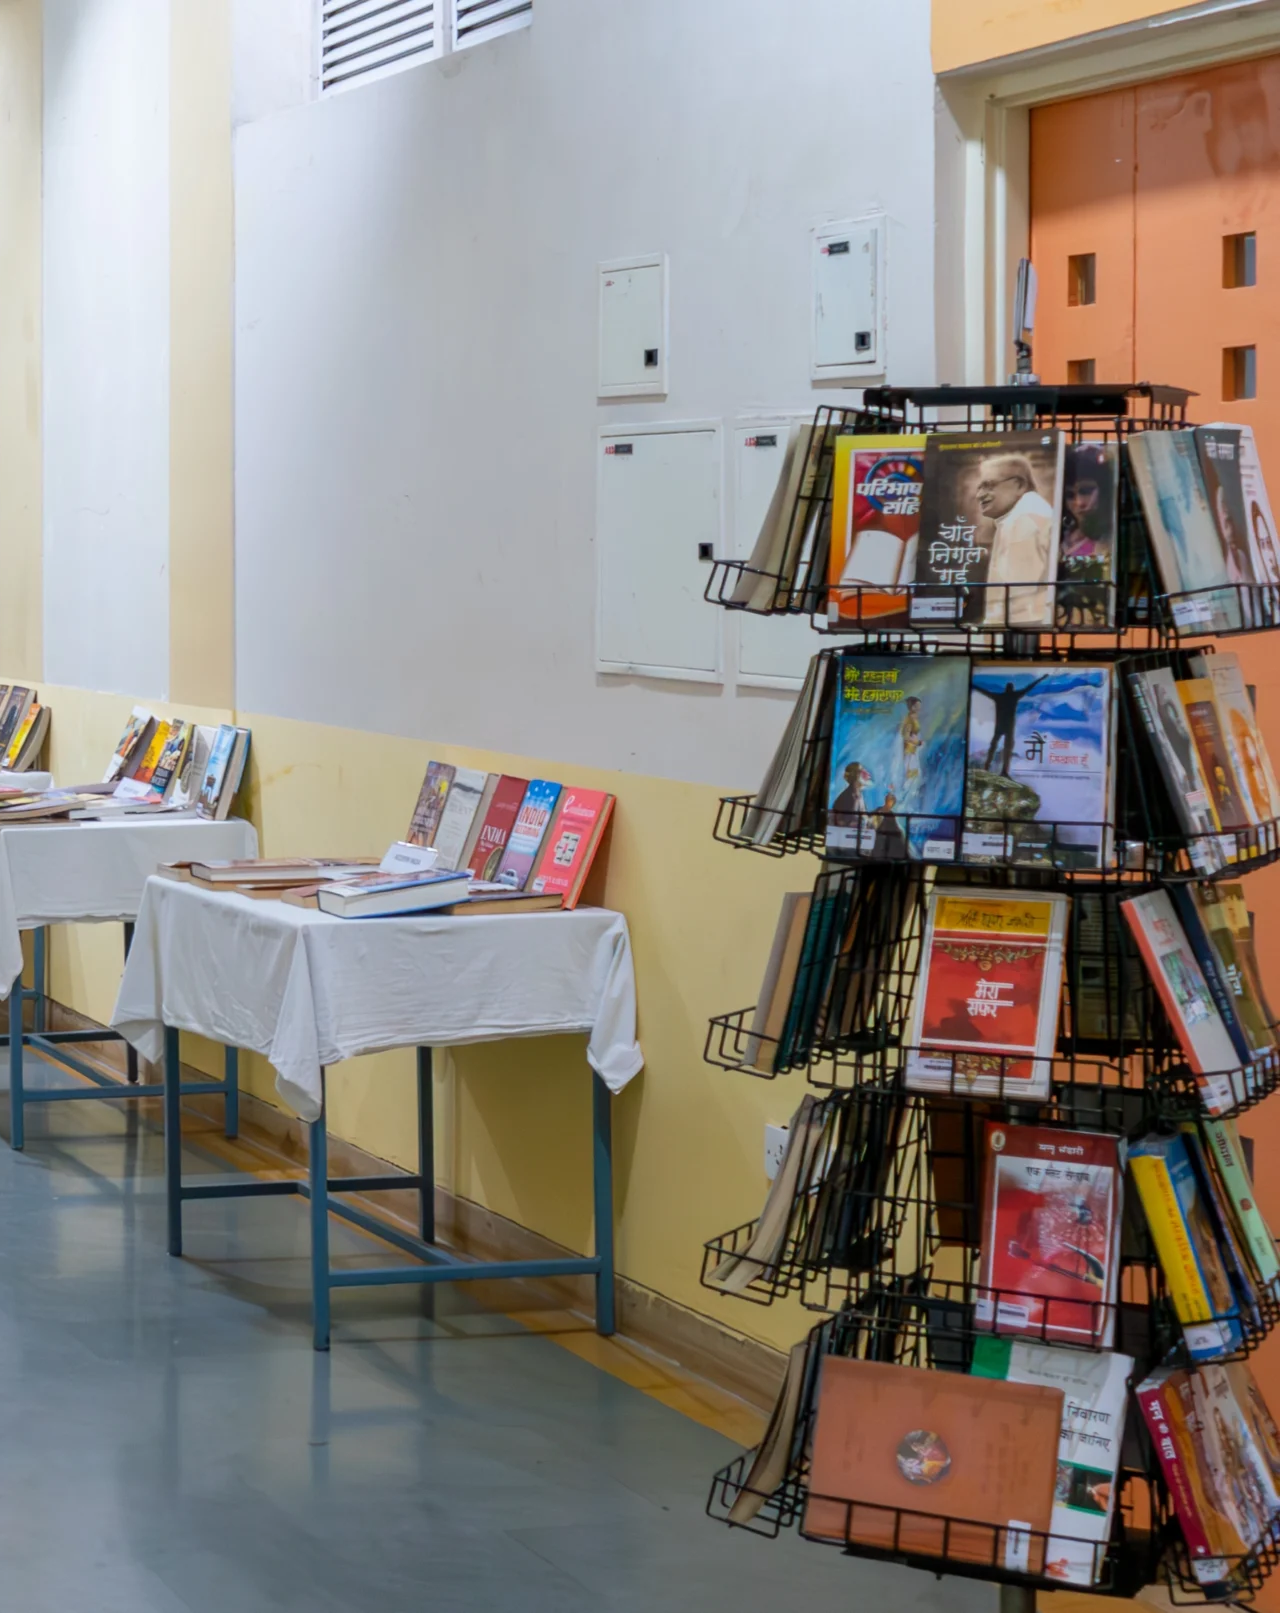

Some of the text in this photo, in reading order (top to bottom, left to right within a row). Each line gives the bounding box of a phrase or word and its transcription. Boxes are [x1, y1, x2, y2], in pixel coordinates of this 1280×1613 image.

[856, 478, 924, 496] परिभाष
[883, 497, 921, 515] संहि
[928, 541, 988, 564] निगल
[1024, 731, 1046, 764] मैं
[521, 806, 547, 827] INDIA
[481, 825, 507, 845] INDIA
[975, 977, 1014, 1000] मेरा
[1067, 1401, 1112, 1425] निवारण
